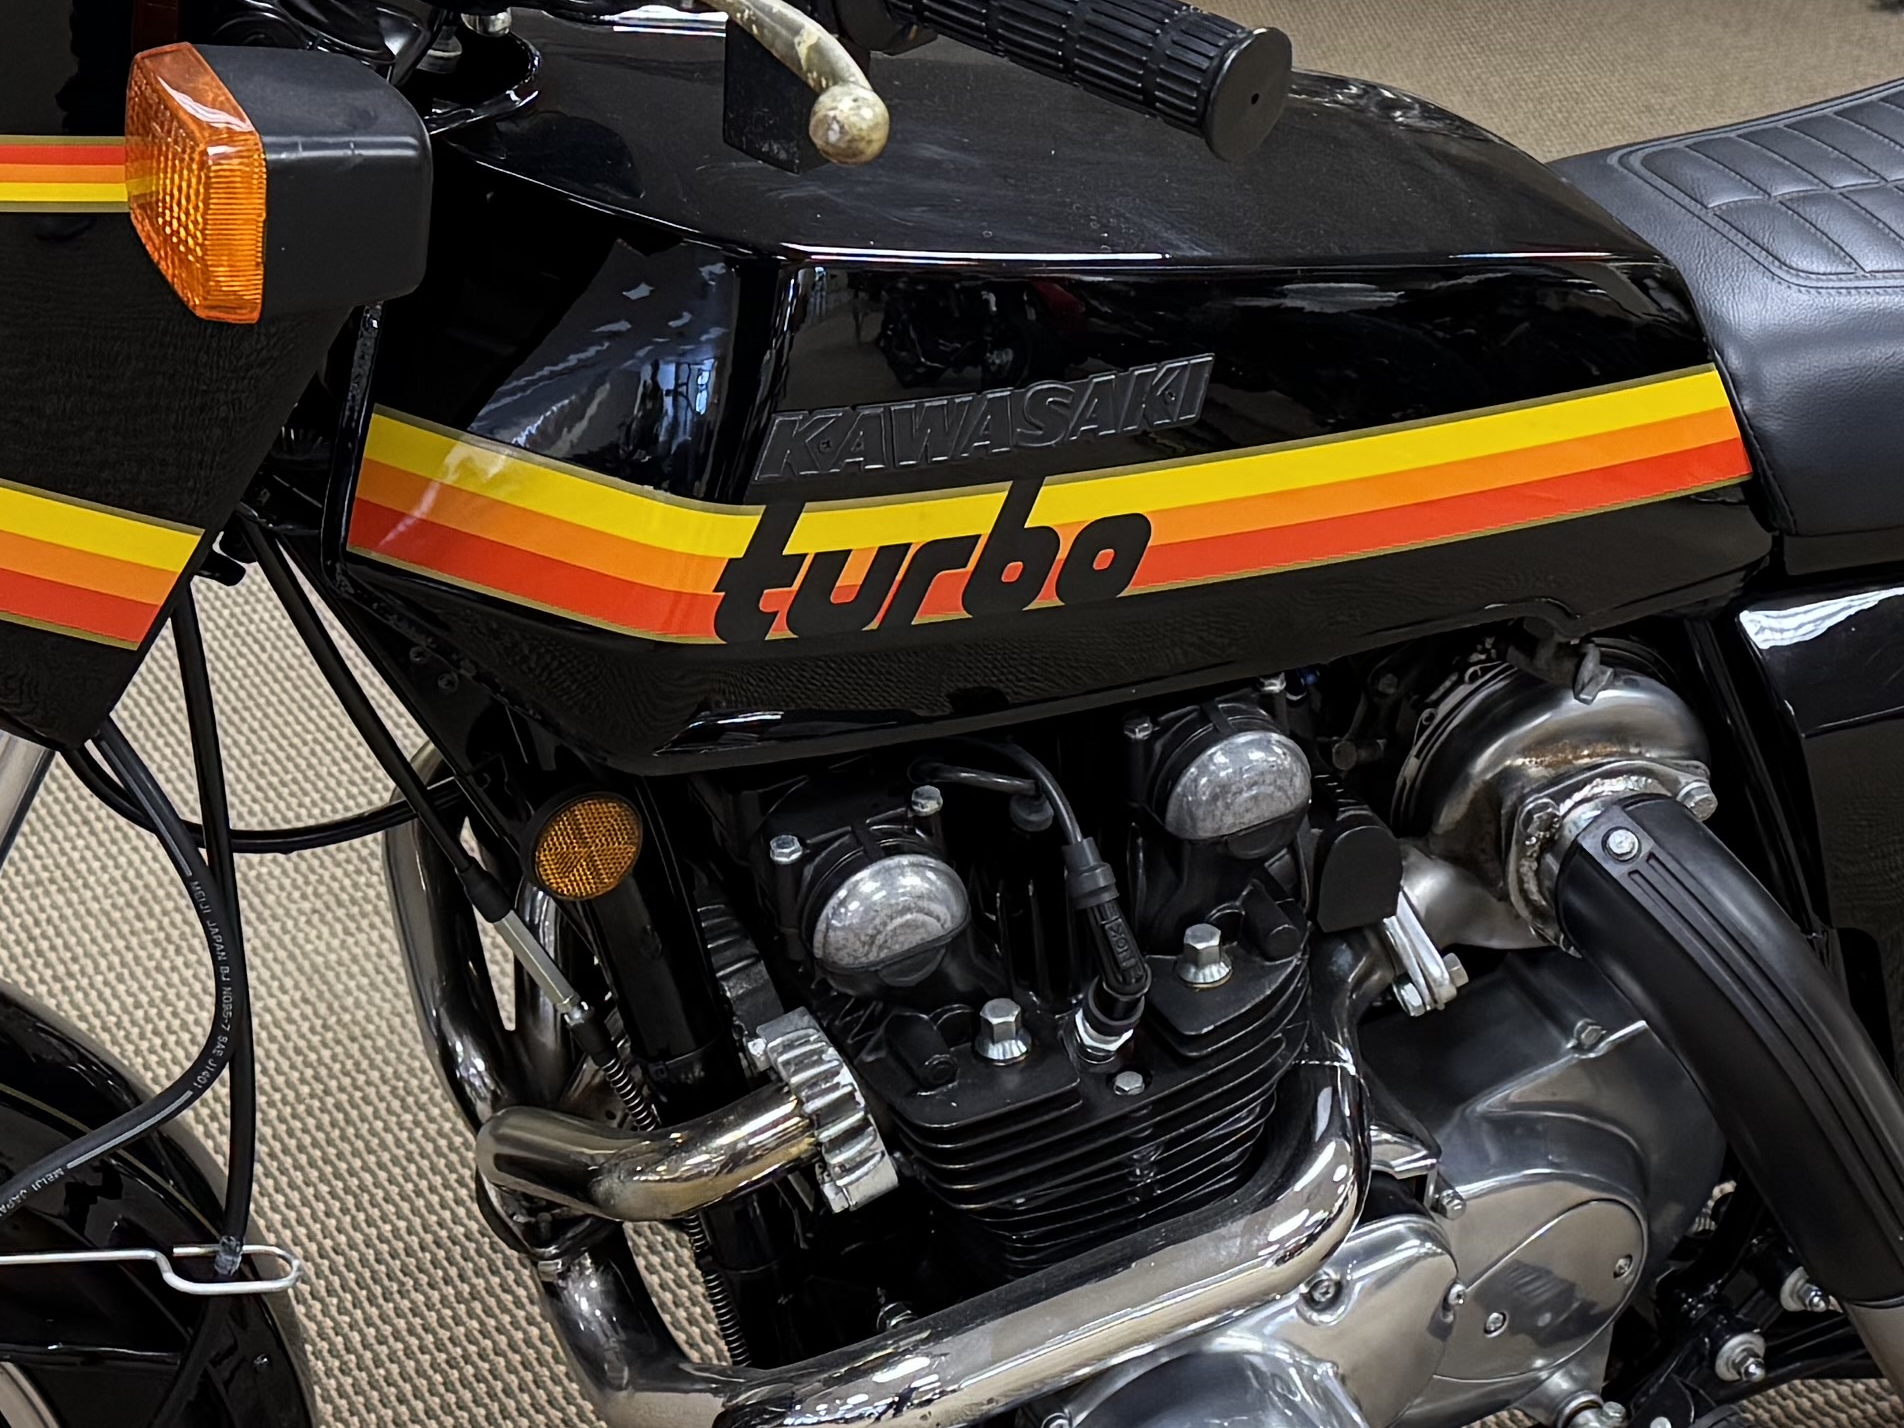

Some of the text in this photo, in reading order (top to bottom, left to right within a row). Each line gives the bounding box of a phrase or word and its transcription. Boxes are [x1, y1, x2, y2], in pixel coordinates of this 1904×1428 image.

[754, 353, 1215, 482] KAWASAKI
[713, 475, 1153, 645] turbo
[206, 920, 228, 961] JAPAN
[212, 1035, 228, 1057] SAE
